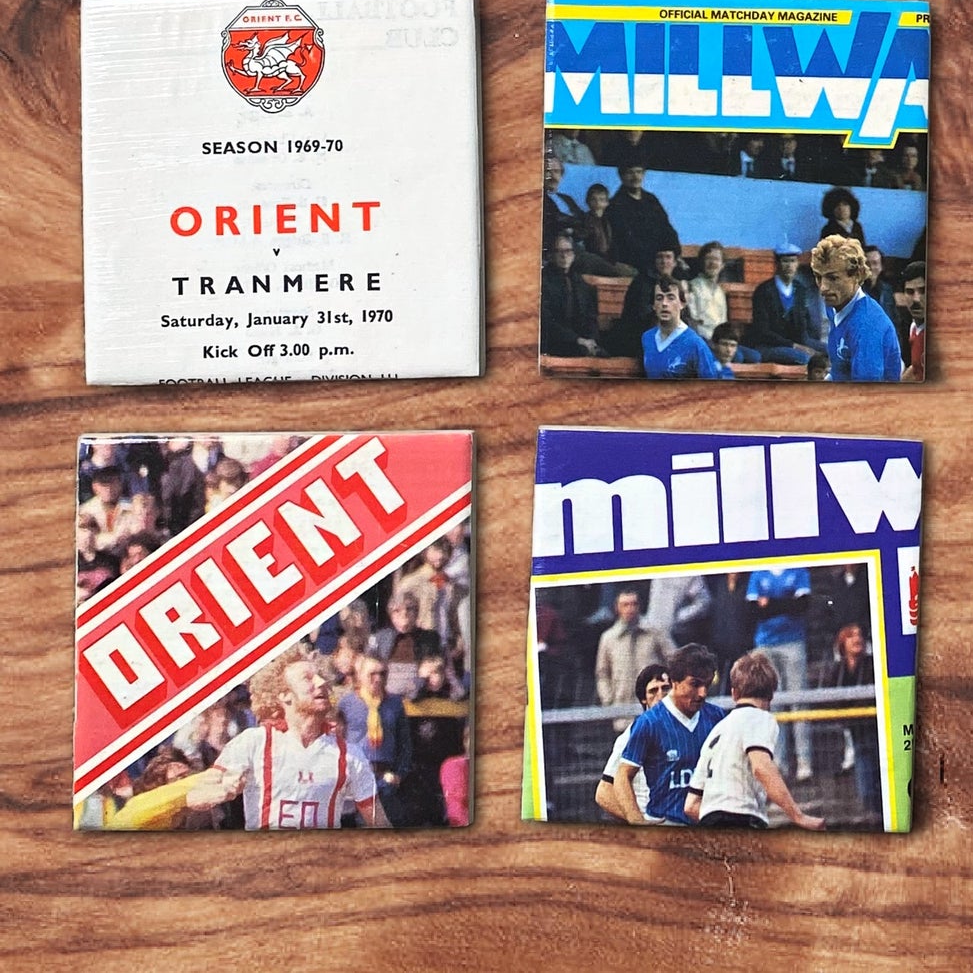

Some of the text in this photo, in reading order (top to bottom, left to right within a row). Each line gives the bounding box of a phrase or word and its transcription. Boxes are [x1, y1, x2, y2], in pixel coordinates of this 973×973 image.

[242, 15, 281, 23] ORIENT
[659, 9, 708, 19] OFFICIAL
[710, 10, 775, 21] MATCHDAY
[777, 11, 838, 22] MAGAZINE
[202, 139, 343, 155] SEASON 1969-70
[170, 202, 380, 237] ORIENT
[172, 272, 380, 295] TRANMERE
[161, 309, 393, 330] Saturday, January 31st, 1970
[203, 343, 354, 359] Kick Off 3.00 p.m.
[81, 436, 406, 719] ORIENT
